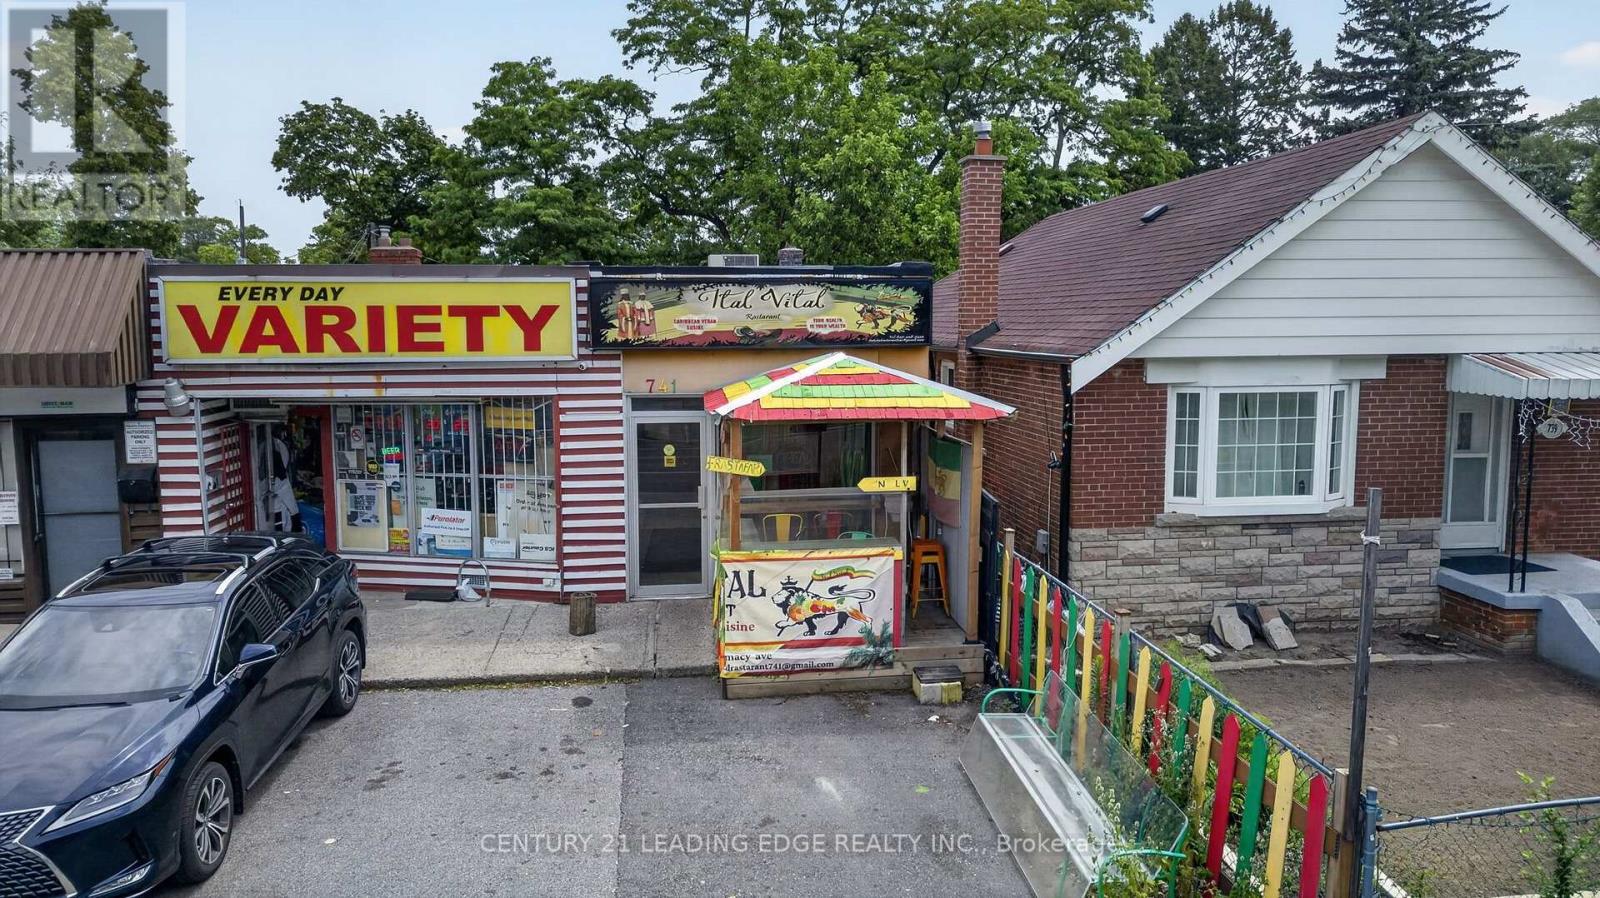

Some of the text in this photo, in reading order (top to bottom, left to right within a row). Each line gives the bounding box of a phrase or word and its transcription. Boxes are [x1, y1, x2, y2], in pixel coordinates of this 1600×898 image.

[217, 286, 345, 301] EVERY DAY
[698, 288, 827, 309] Ital Vital
[176, 304, 560, 354] VARIETY
[646, 379, 676, 394] 741
[381, 447, 401, 455] BEER
[434, 514, 466, 524] Purolator
[727, 569, 767, 599] AL
